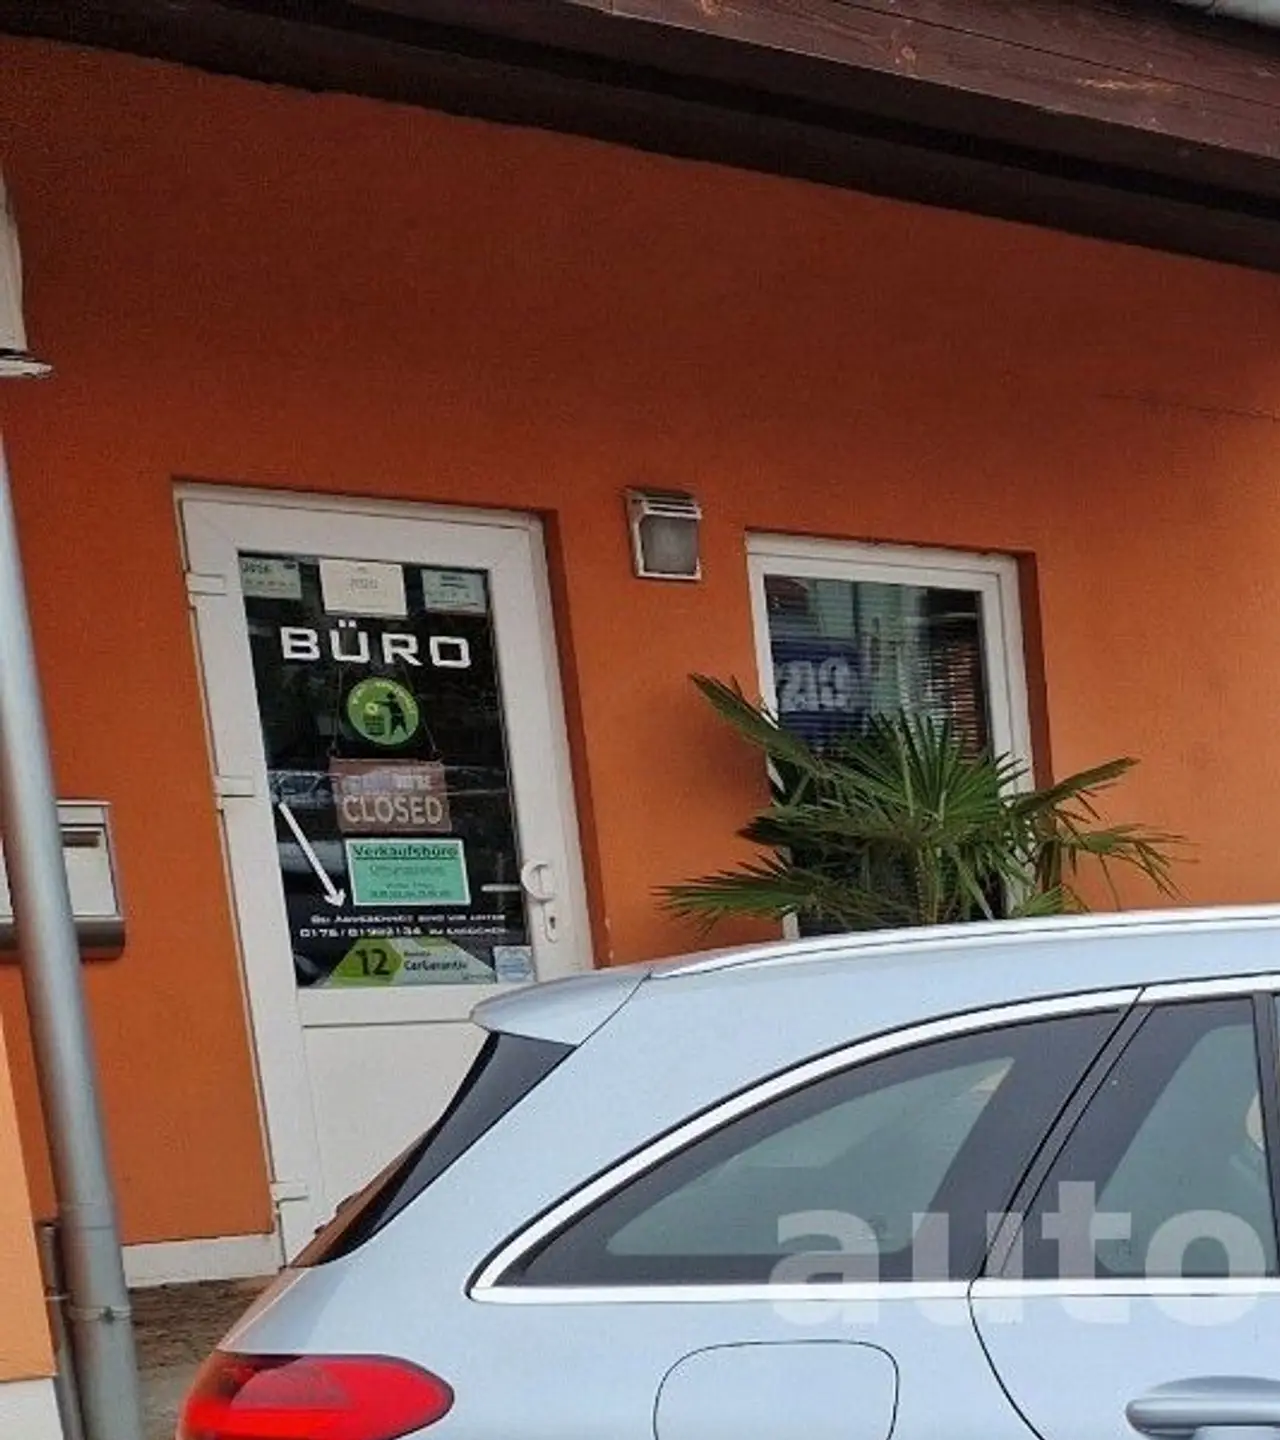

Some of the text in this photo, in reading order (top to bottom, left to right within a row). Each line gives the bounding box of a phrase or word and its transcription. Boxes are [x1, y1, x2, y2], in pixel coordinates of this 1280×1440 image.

[280, 619, 472, 668] BÜRO
[342, 795, 443, 825] CLOSED
[357, 949, 391, 976] 12
